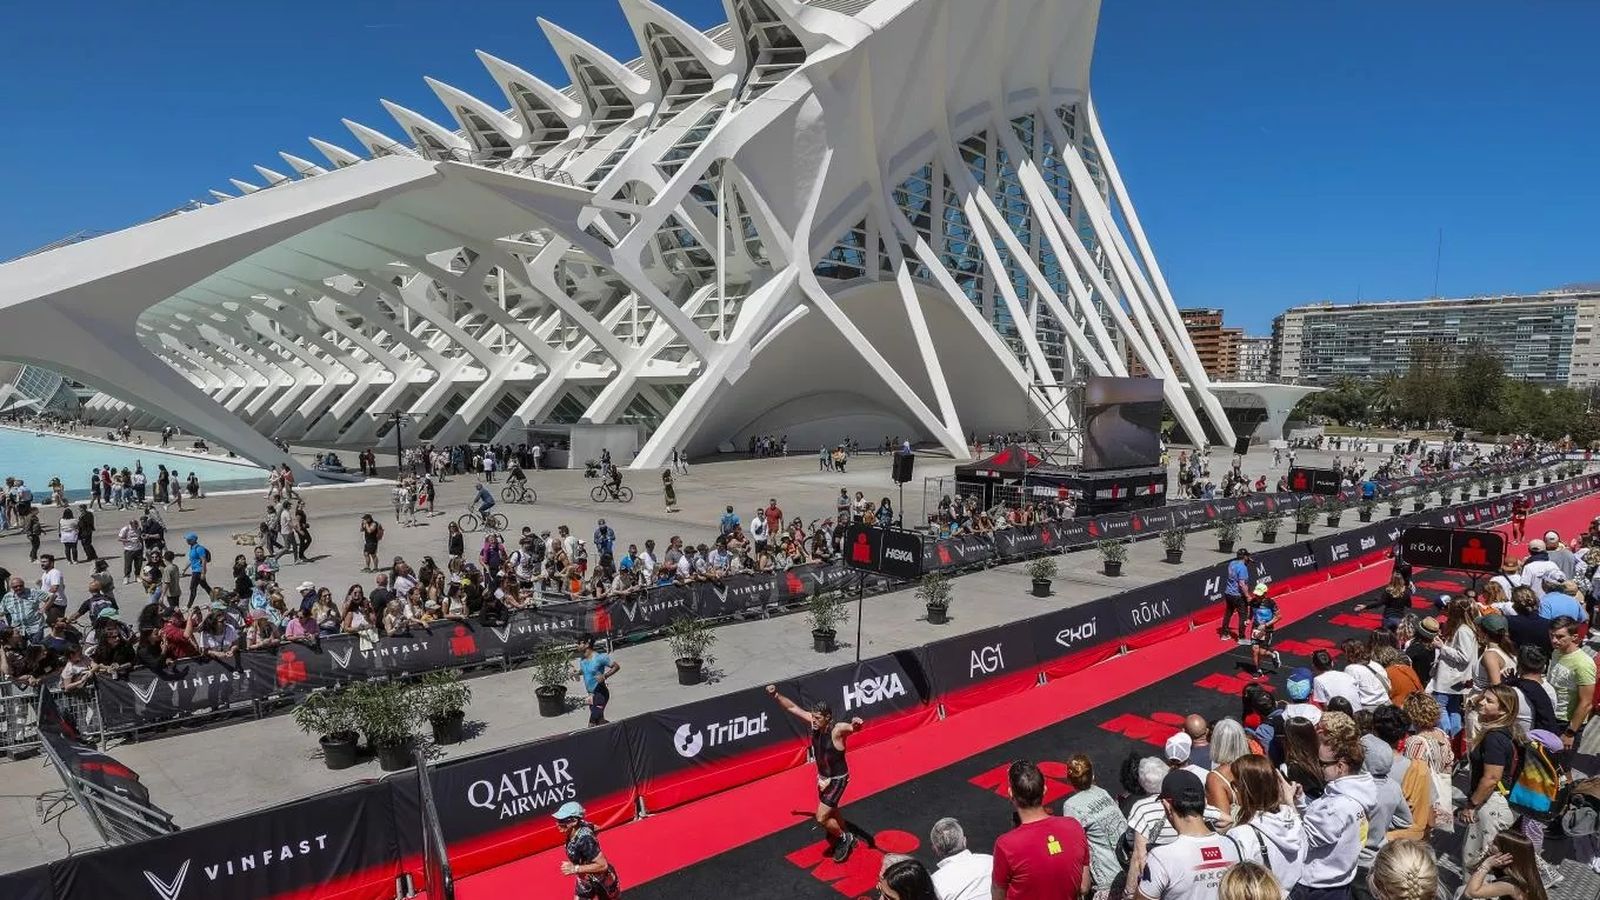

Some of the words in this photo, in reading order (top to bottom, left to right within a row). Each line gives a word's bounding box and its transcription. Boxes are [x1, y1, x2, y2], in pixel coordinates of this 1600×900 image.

[885, 547, 914, 563] HOKA
[733, 582, 776, 596] VINFAST
[641, 598, 685, 614] VINFAST
[518, 618, 574, 634] VINFAST
[360, 641, 429, 659] VINFAST
[970, 642, 1005, 679] AG1
[168, 669, 252, 692] VINFAST
[842, 672, 906, 712] HOKA
[707, 711, 768, 747] TriDot
[467, 758, 574, 810] QATAR
[500, 782, 576, 820] AIRWAYS
[204, 834, 329, 882] VINFAST
